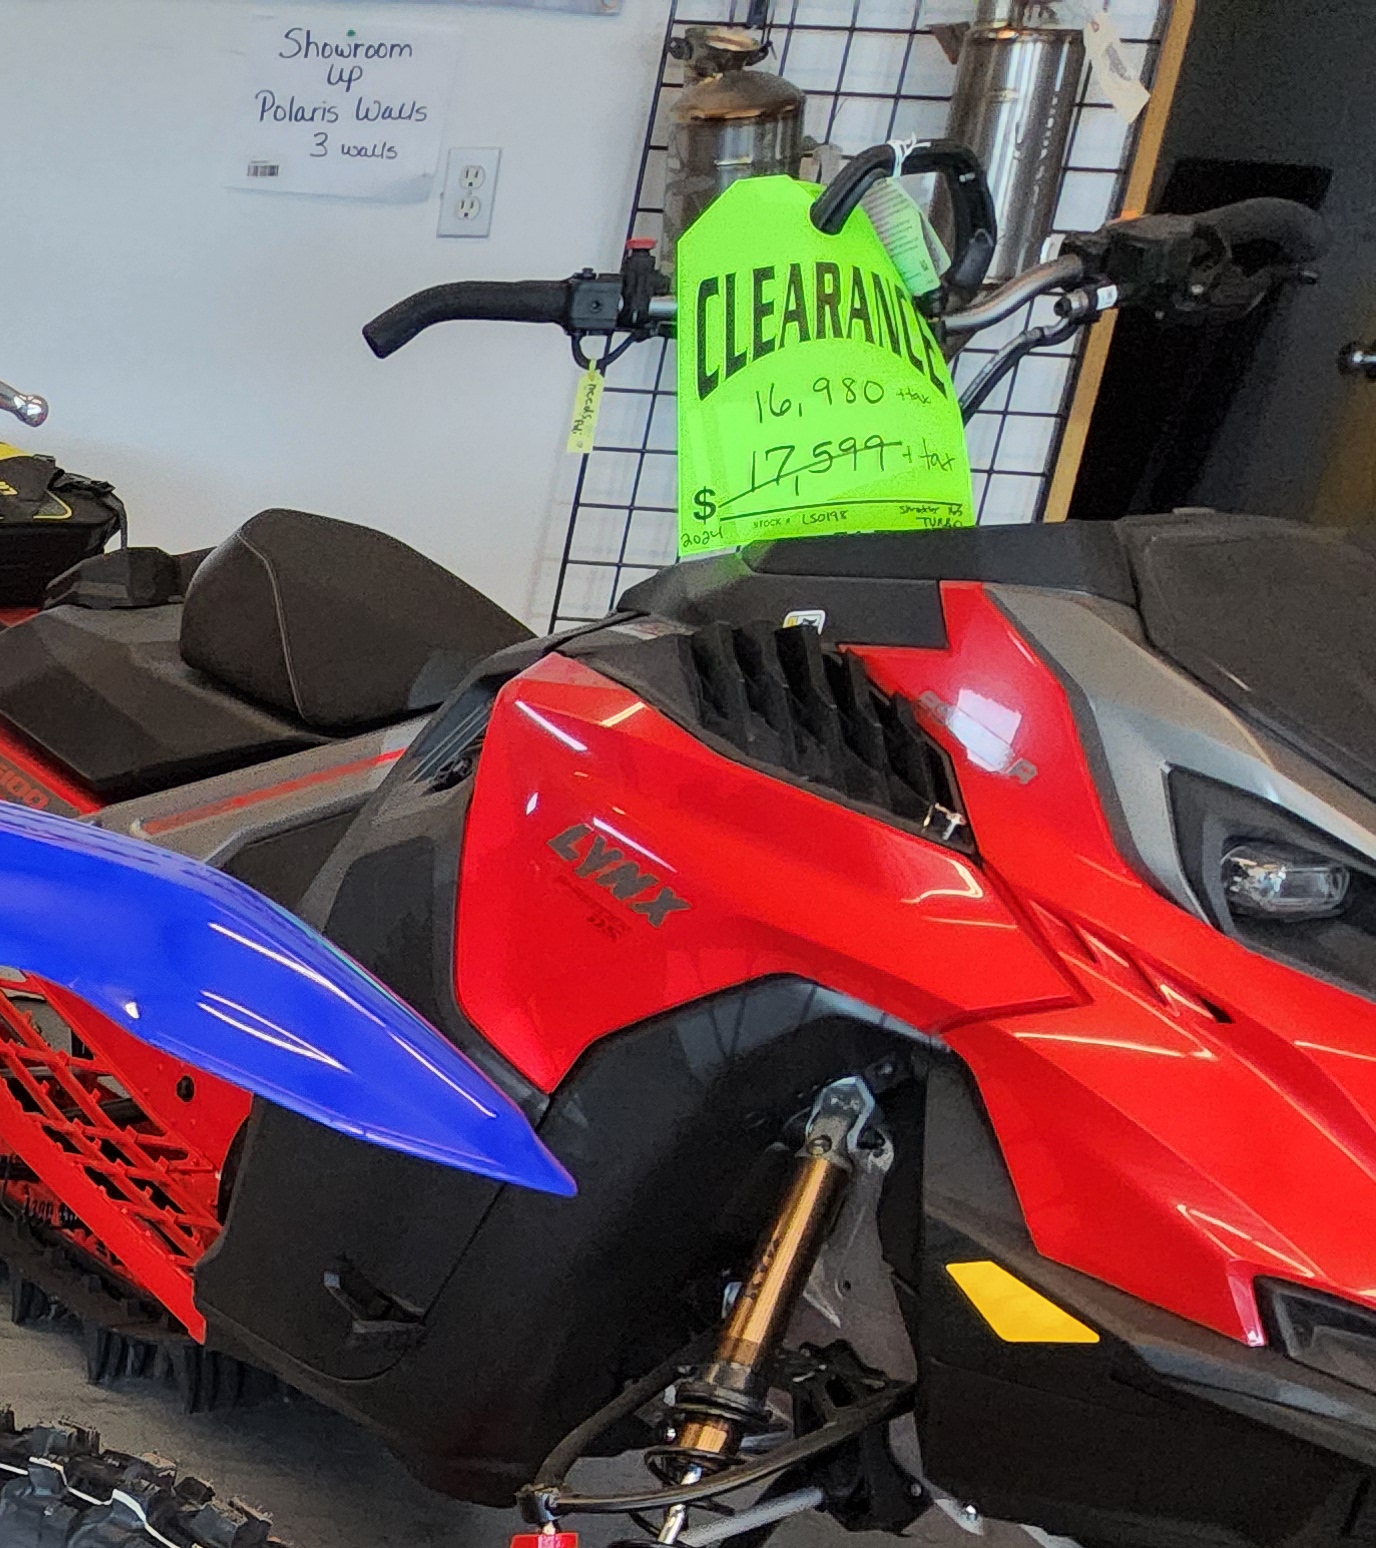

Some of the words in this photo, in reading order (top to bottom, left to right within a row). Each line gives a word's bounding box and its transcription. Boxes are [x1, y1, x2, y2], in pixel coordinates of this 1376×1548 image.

[279, 27, 413, 59] Showroom
[254, 89, 340, 123] Polaris
[355, 96, 428, 122] Walls
[309, 131, 329, 158] 3
[340, 141, 399, 160] walls
[696, 260, 948, 401] CLEARANCE
[693, 485, 717, 525] $
[680, 526, 723, 549] 2024
[546, 822, 693, 929] LYNX
